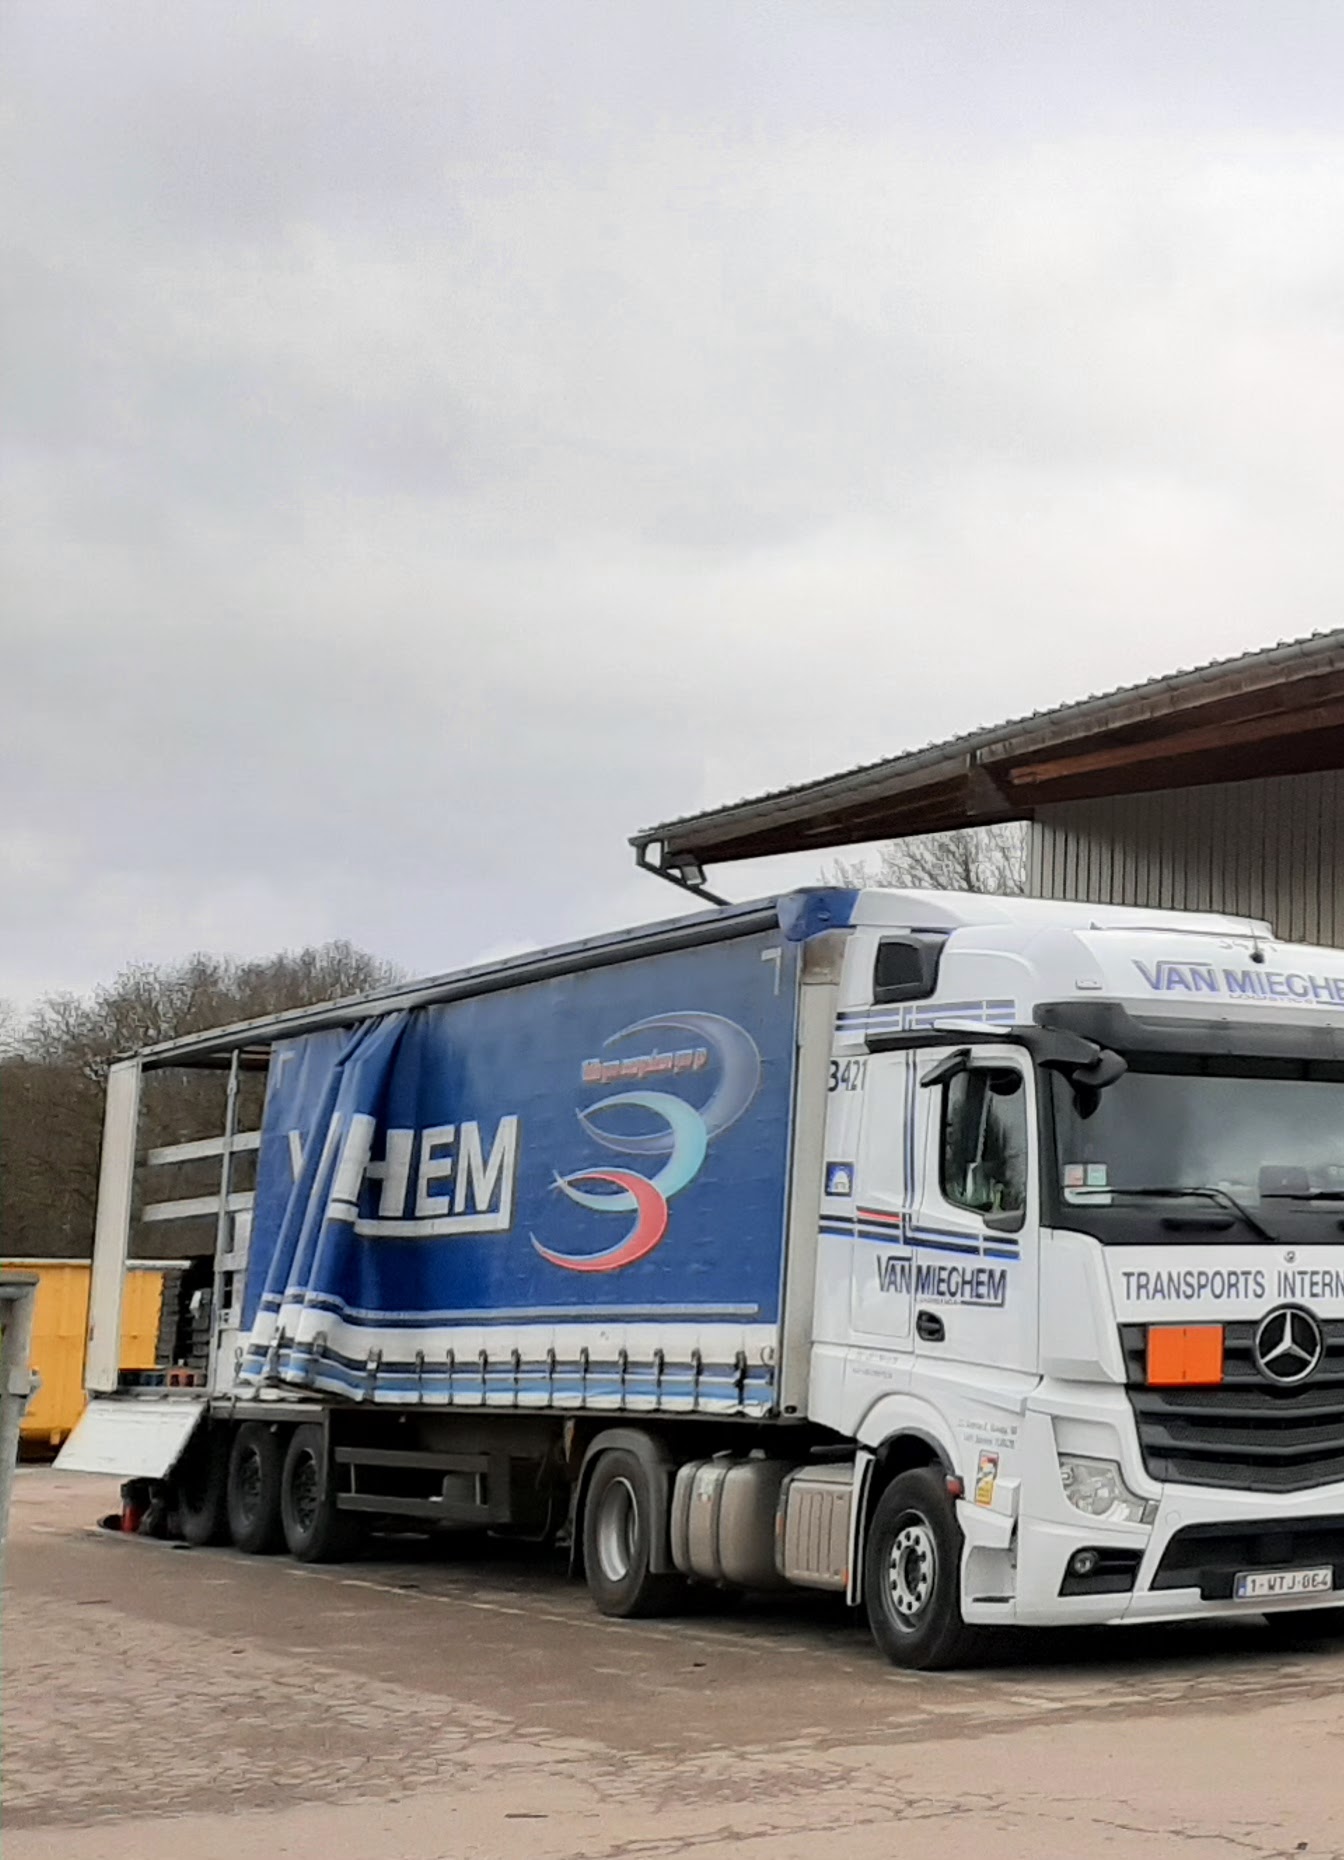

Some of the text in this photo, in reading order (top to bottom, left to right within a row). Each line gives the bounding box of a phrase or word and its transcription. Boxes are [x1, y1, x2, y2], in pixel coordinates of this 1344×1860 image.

[1131, 959, 1220, 992] VAN
[828, 1059, 867, 1092] 3421
[876, 1254, 1007, 1308] VAN MIEGHEM
[1122, 1270, 1266, 1301] TRANSPORTS
